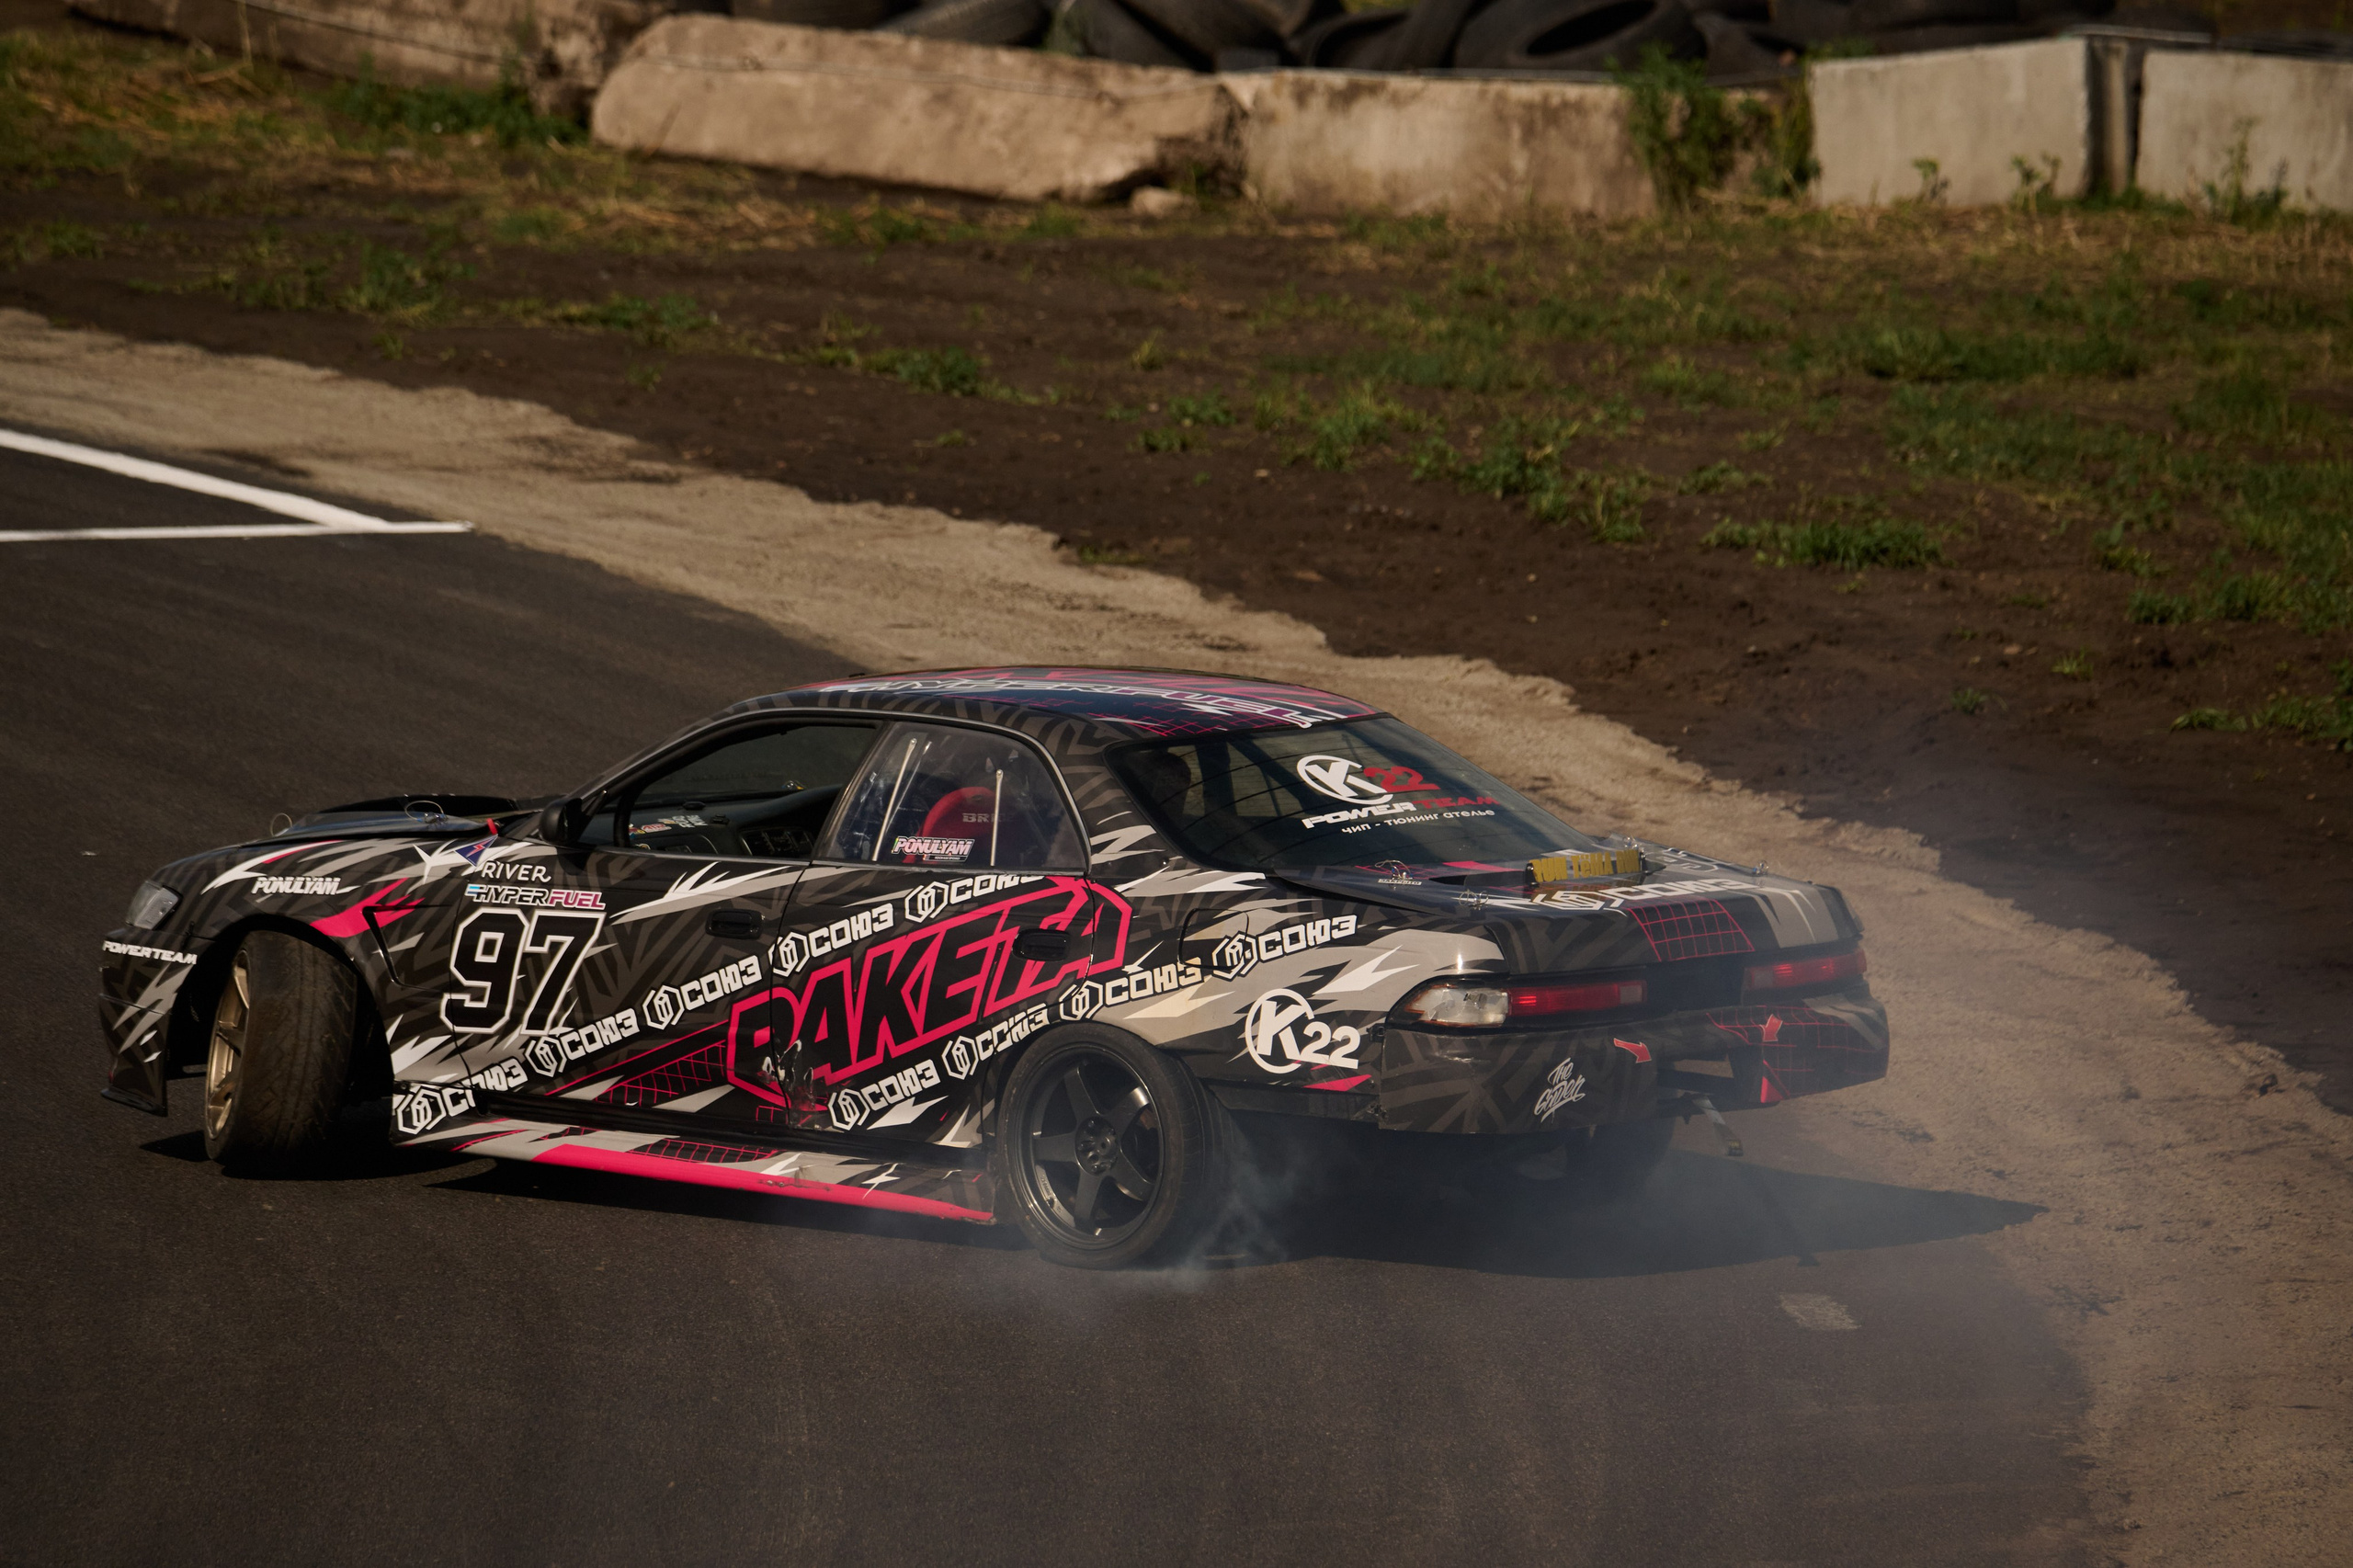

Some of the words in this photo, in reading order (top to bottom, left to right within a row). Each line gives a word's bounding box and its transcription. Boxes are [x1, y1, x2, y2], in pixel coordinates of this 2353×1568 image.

[1297, 756, 1440, 804] K22
[481, 860, 551, 883] RIVER
[949, 874, 1045, 904] СОЮ
[439, 907, 607, 1036] 97
[1247, 990, 1360, 1074] K22
